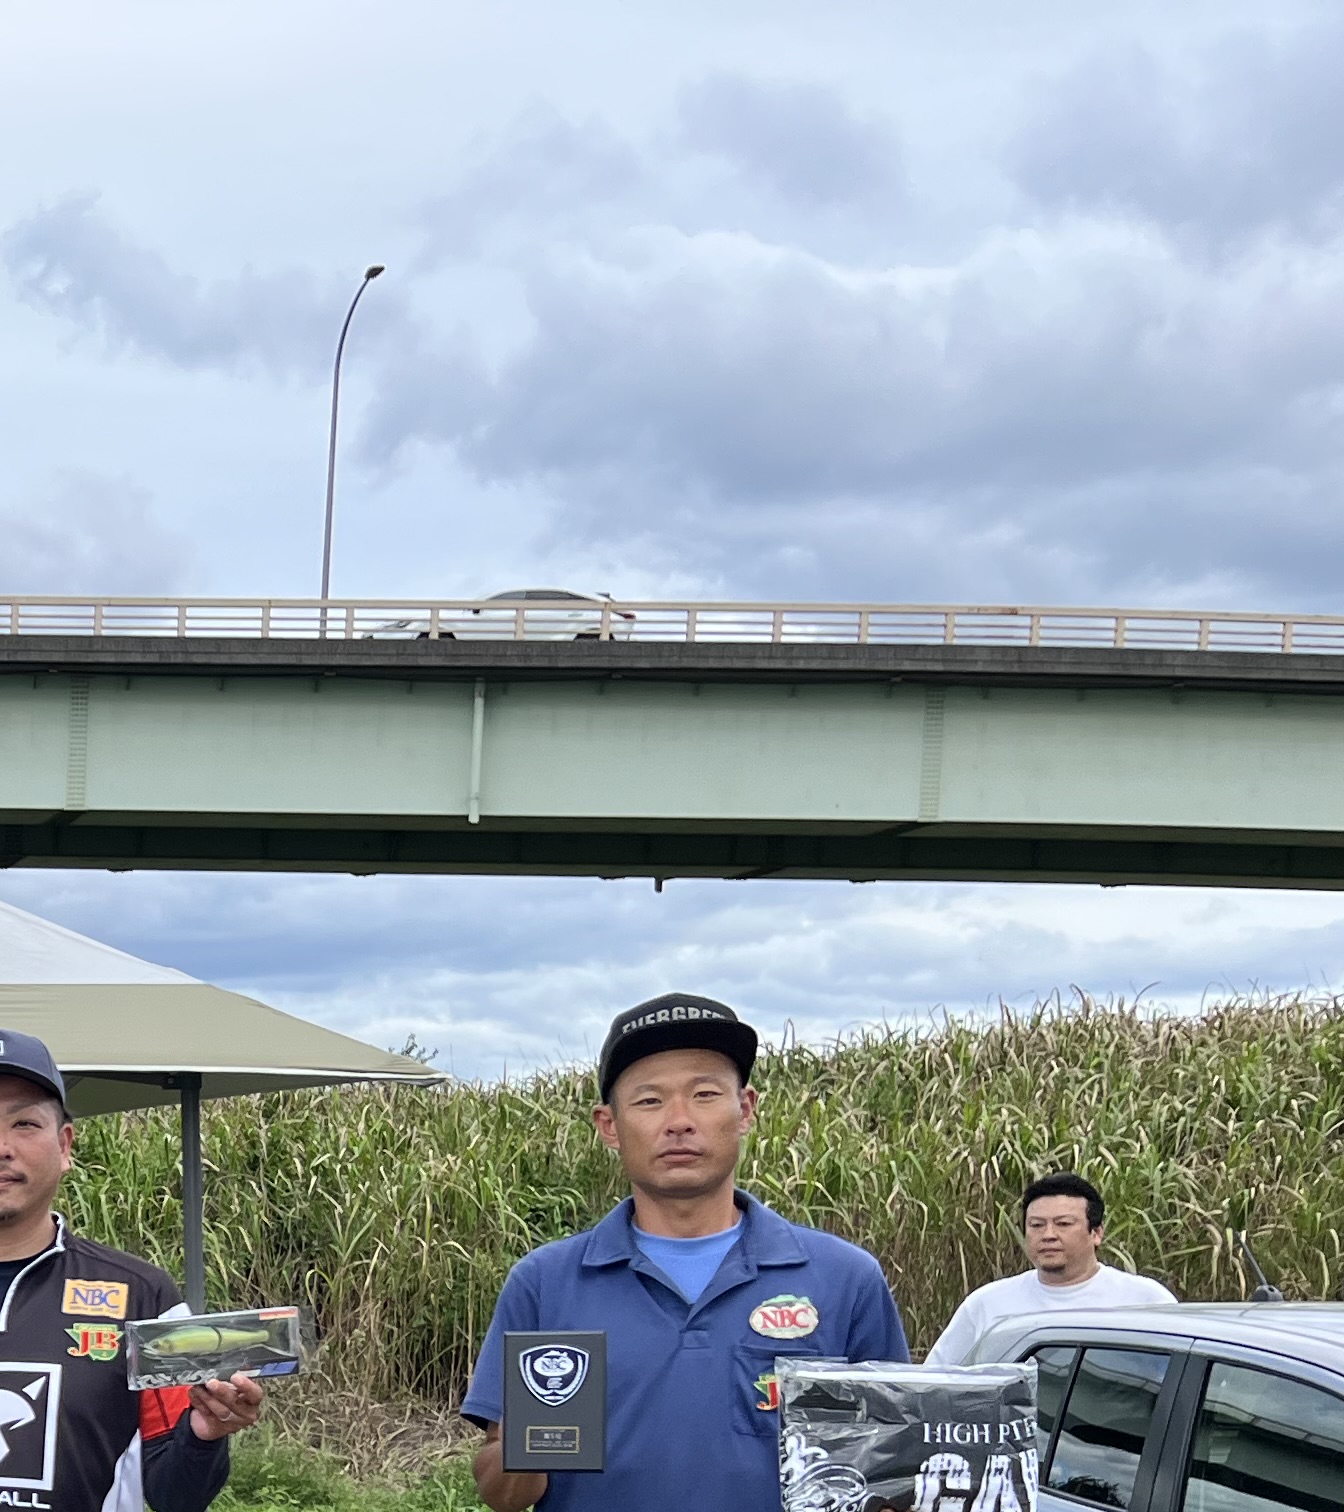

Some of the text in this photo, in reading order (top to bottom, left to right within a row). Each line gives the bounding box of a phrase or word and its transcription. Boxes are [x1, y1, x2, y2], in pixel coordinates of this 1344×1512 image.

[70, 1287, 120, 1308] NBC
[759, 1308, 809, 1329] NBC
[67, 1331, 120, 1357] JB
[540, 1359, 567, 1371] NBC
[756, 1381, 778, 1410] J
[923, 1422, 991, 1445] HIGH
